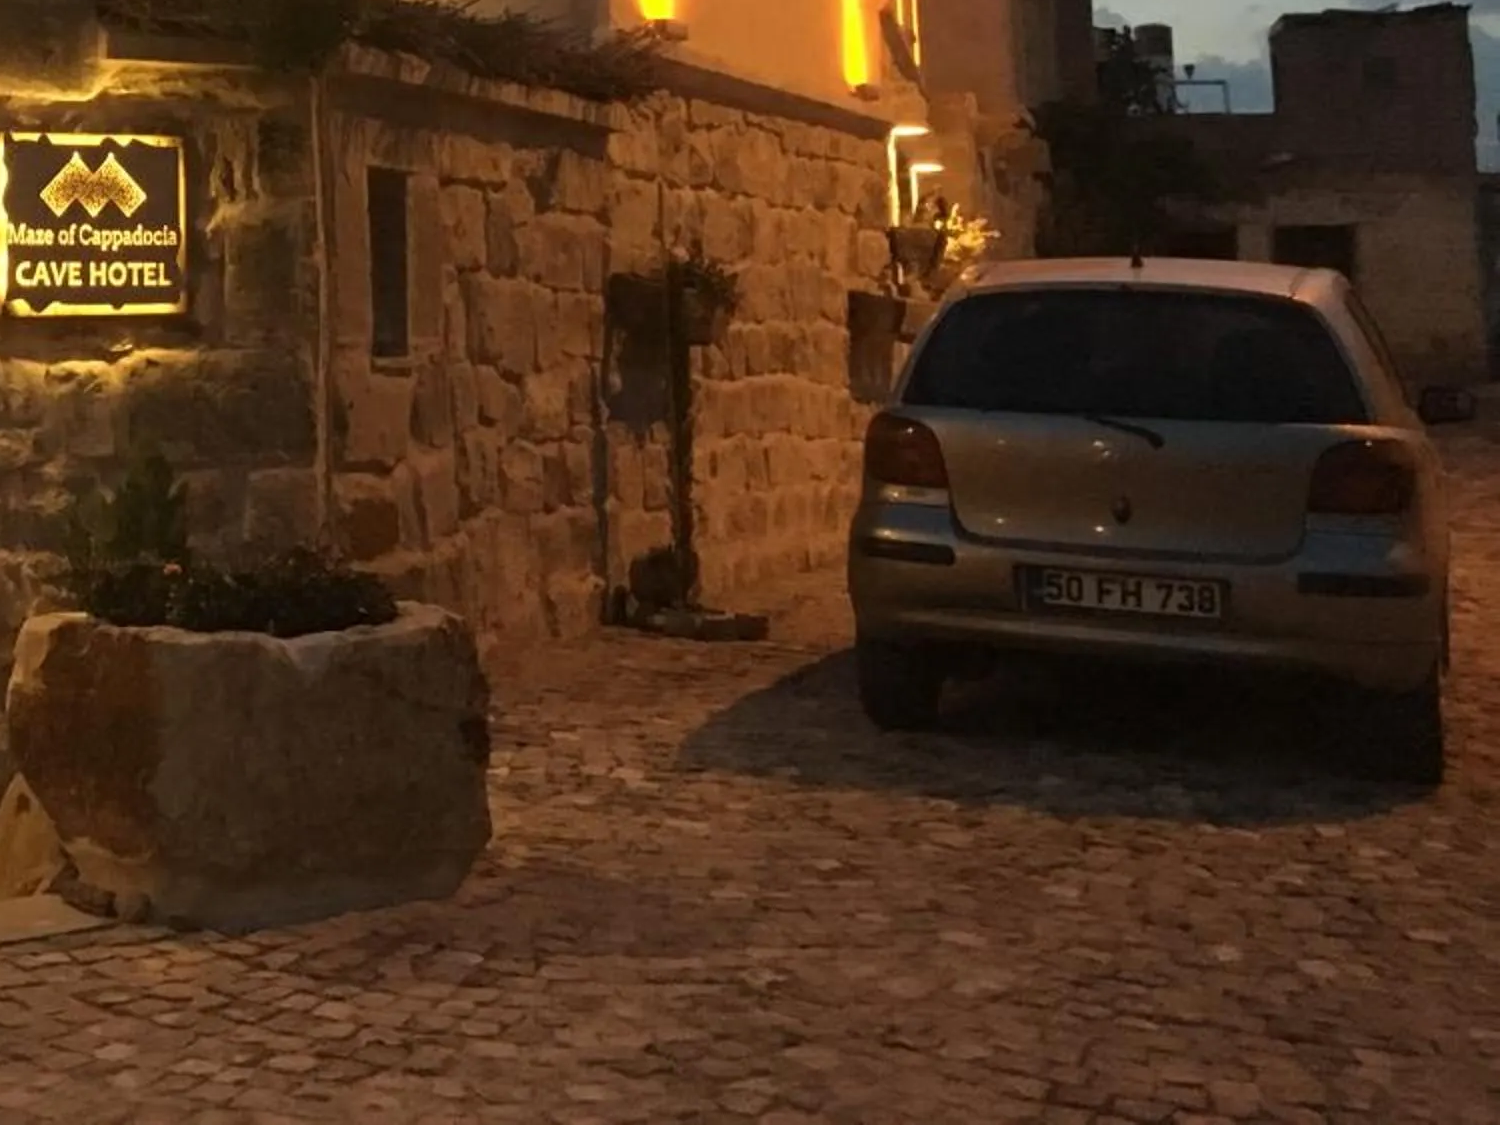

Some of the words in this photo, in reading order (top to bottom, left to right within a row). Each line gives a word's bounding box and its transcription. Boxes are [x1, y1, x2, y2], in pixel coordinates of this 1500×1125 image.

[8, 223, 54, 246] Maze
[58, 224, 77, 246] of
[80, 224, 178, 252] Cappadocia
[15, 261, 83, 287] CAVE
[90, 262, 172, 287] HOTEL
[1045, 573, 1084, 603] 50
[1097, 576, 1142, 608] FH
[1156, 582, 1216, 614] 738
